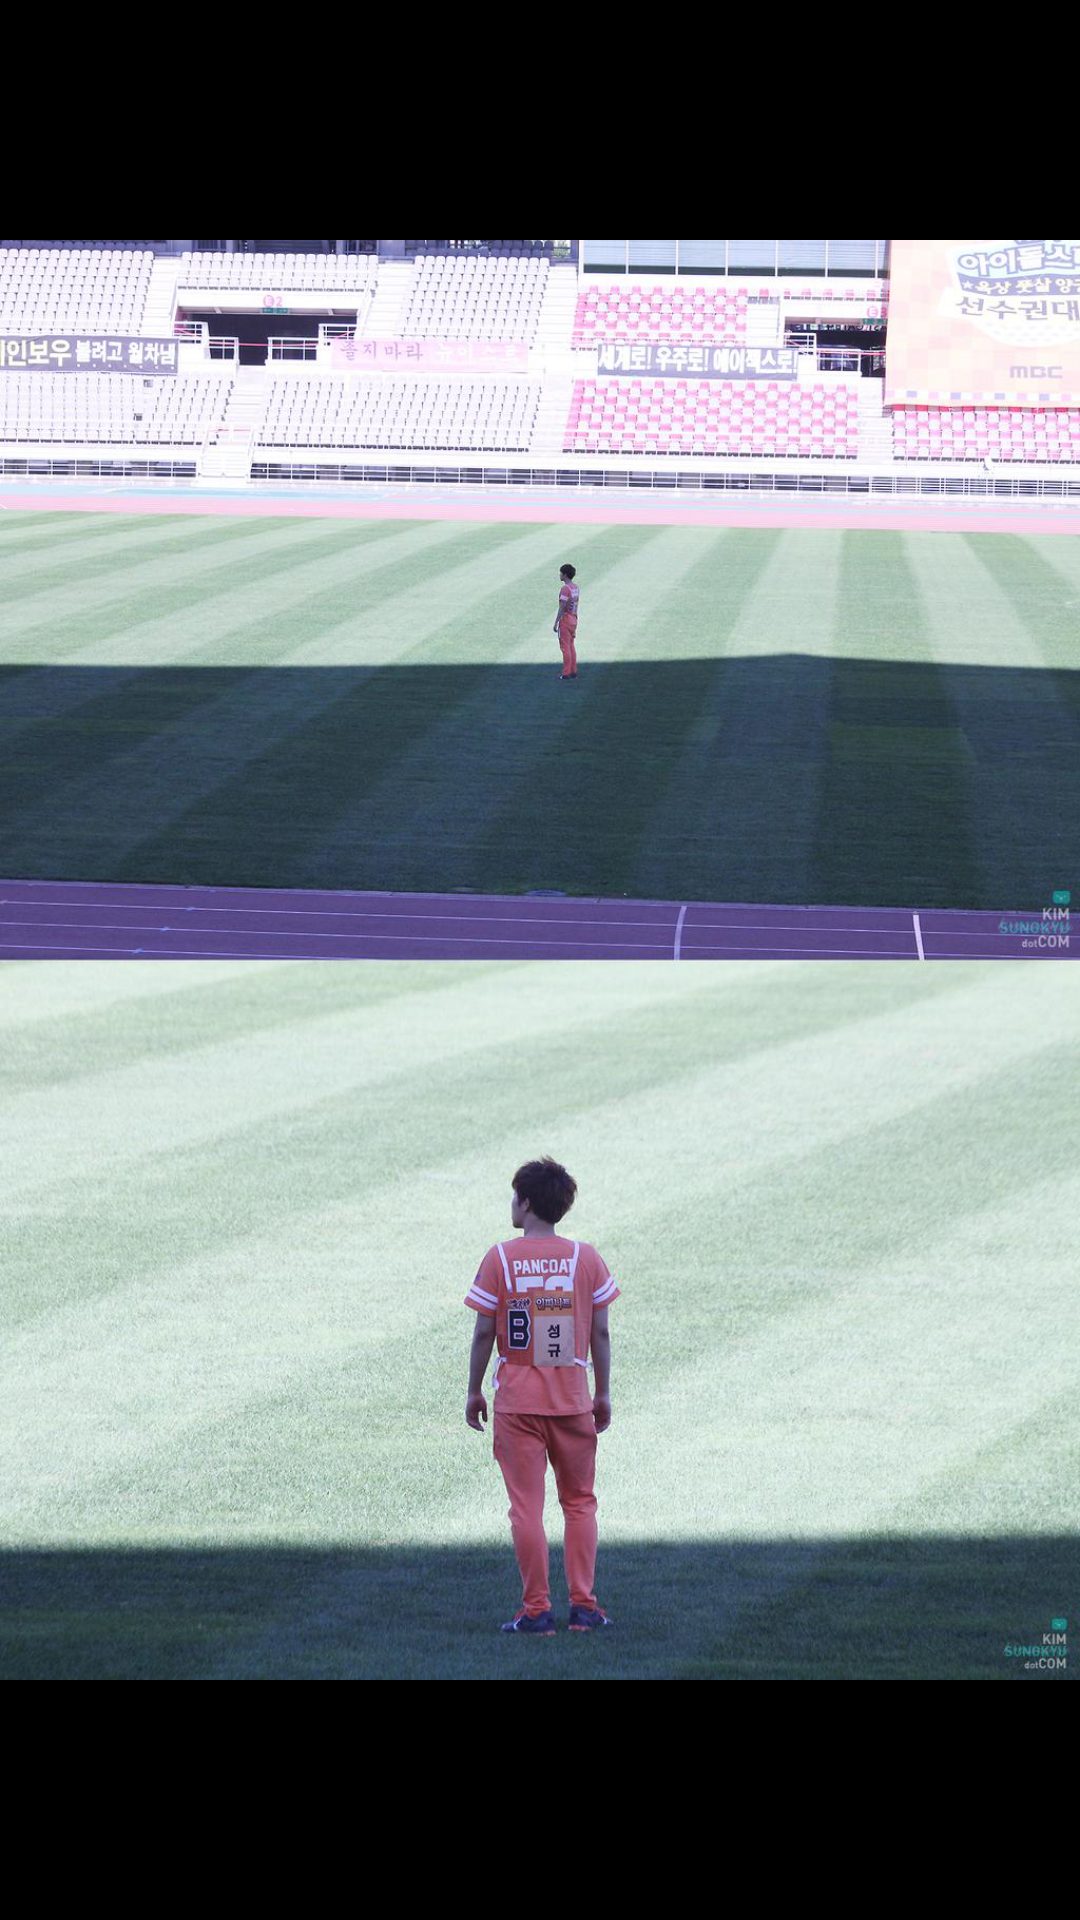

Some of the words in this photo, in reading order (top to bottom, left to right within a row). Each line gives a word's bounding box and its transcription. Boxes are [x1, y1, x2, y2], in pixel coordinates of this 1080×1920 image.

[955, 296, 1080, 321] 선수권대
[0, 339, 72, 367] 인보우
[655, 346, 709, 372] 우주로!
[1009, 366, 1063, 379] MBC
